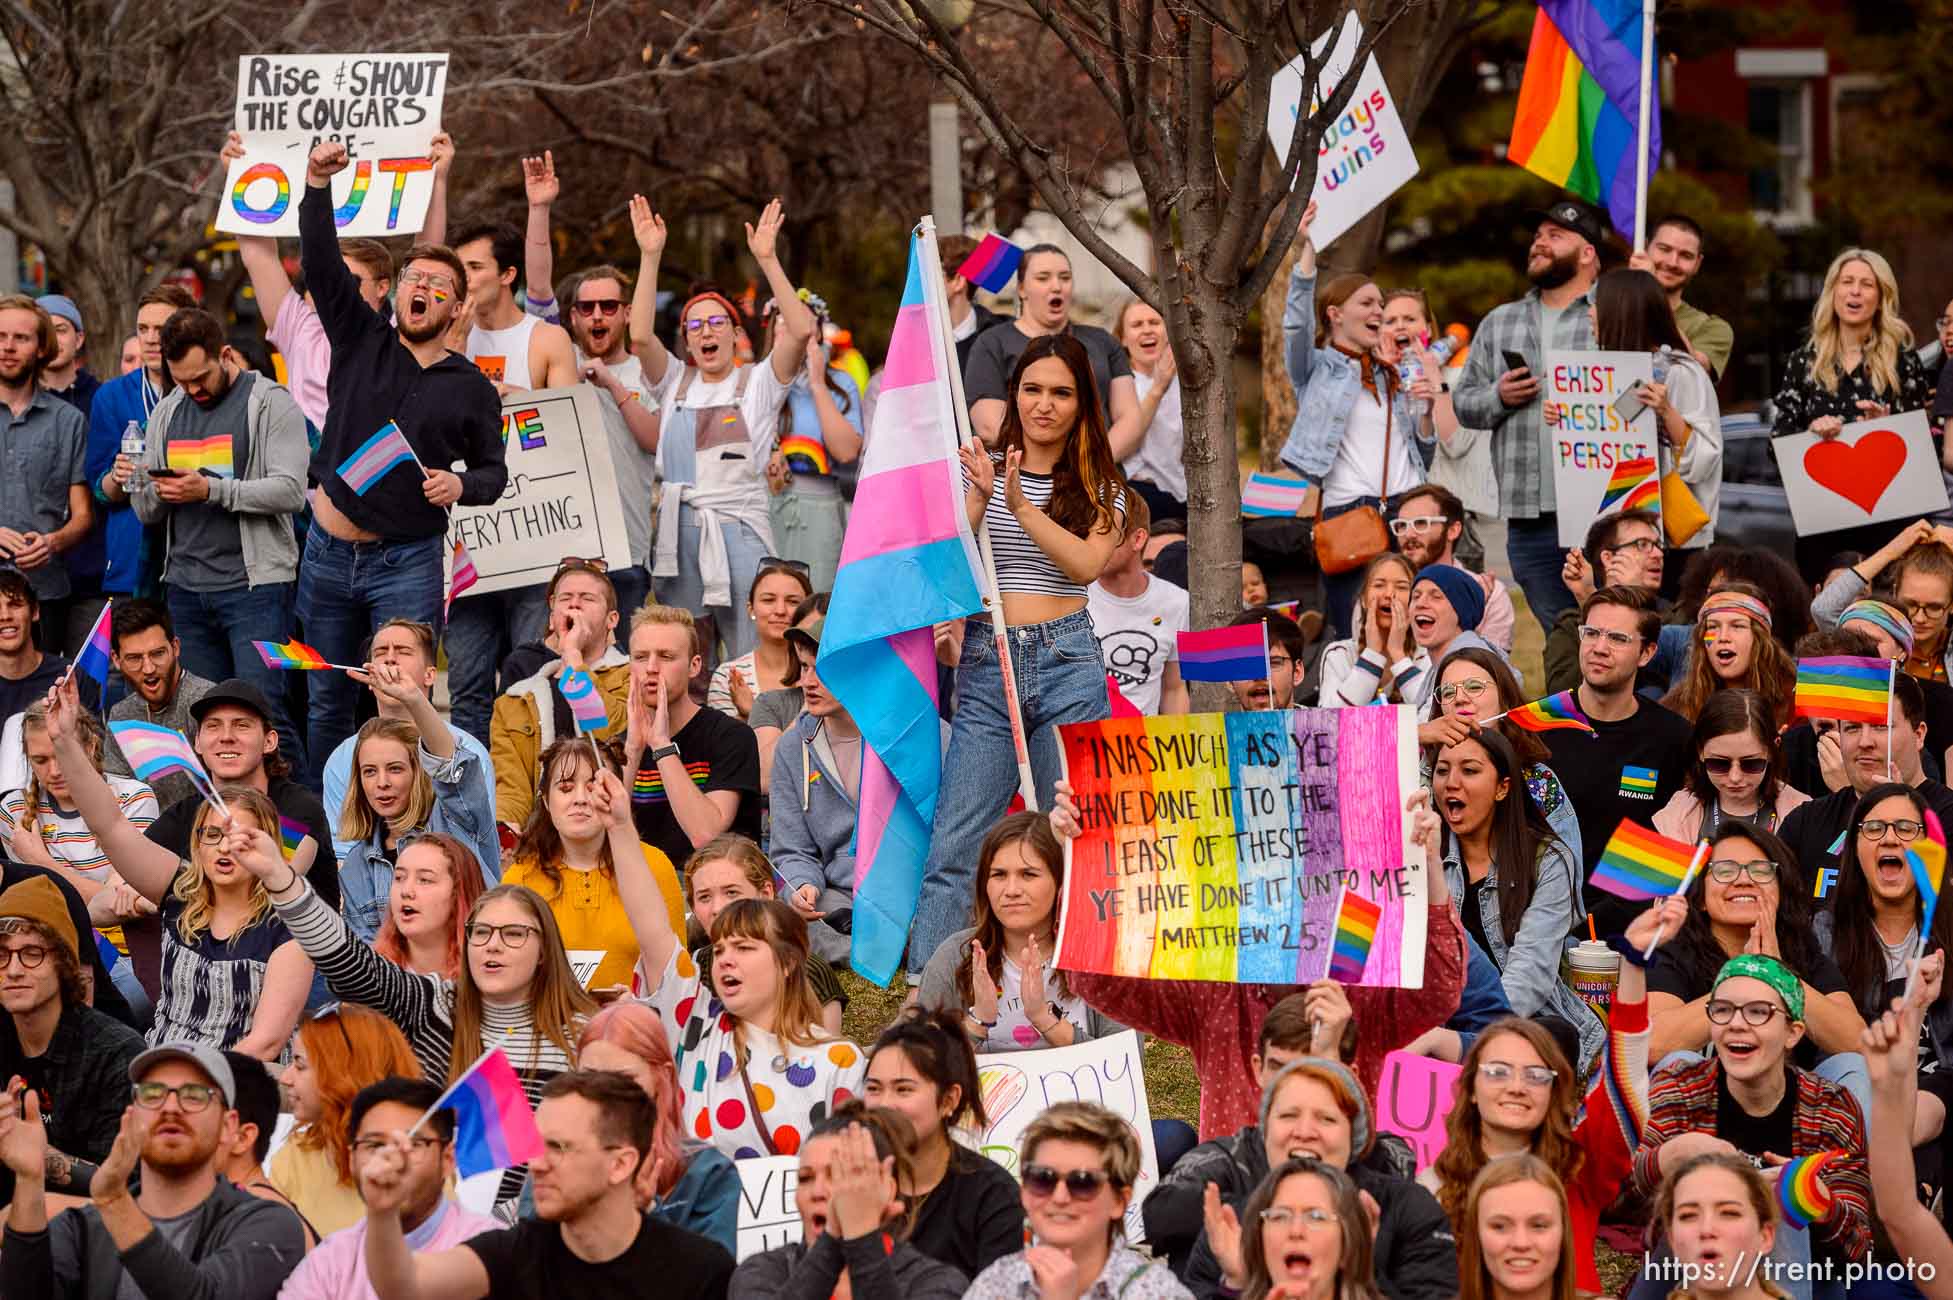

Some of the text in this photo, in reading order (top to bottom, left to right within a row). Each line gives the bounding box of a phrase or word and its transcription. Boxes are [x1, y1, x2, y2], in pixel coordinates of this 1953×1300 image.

[248, 57, 320, 97] Rise
[349, 60, 446, 97] SHOUT
[243, 97, 426, 131] THE COUGARS
[1323, 133, 1386, 191] wins
[444, 496, 583, 551] VERYTHING
[1246, 732, 1280, 767] AS
[1290, 732, 1332, 772] YE
[1075, 784, 1332, 829] HAVE DONE IT TO THE
[1618, 789, 1654, 800] RWANDA
[1105, 834, 1178, 876] LEAST
[1193, 834, 1221, 867] OF
[1089, 888, 1125, 922] YE
[1138, 884, 1189, 914] HAVE
[1201, 882, 1253, 912] DONE
[1266, 877, 1287, 905] IT
[1298, 869, 1359, 901] UNTO
[1580, 994, 1611, 1005] EARS
